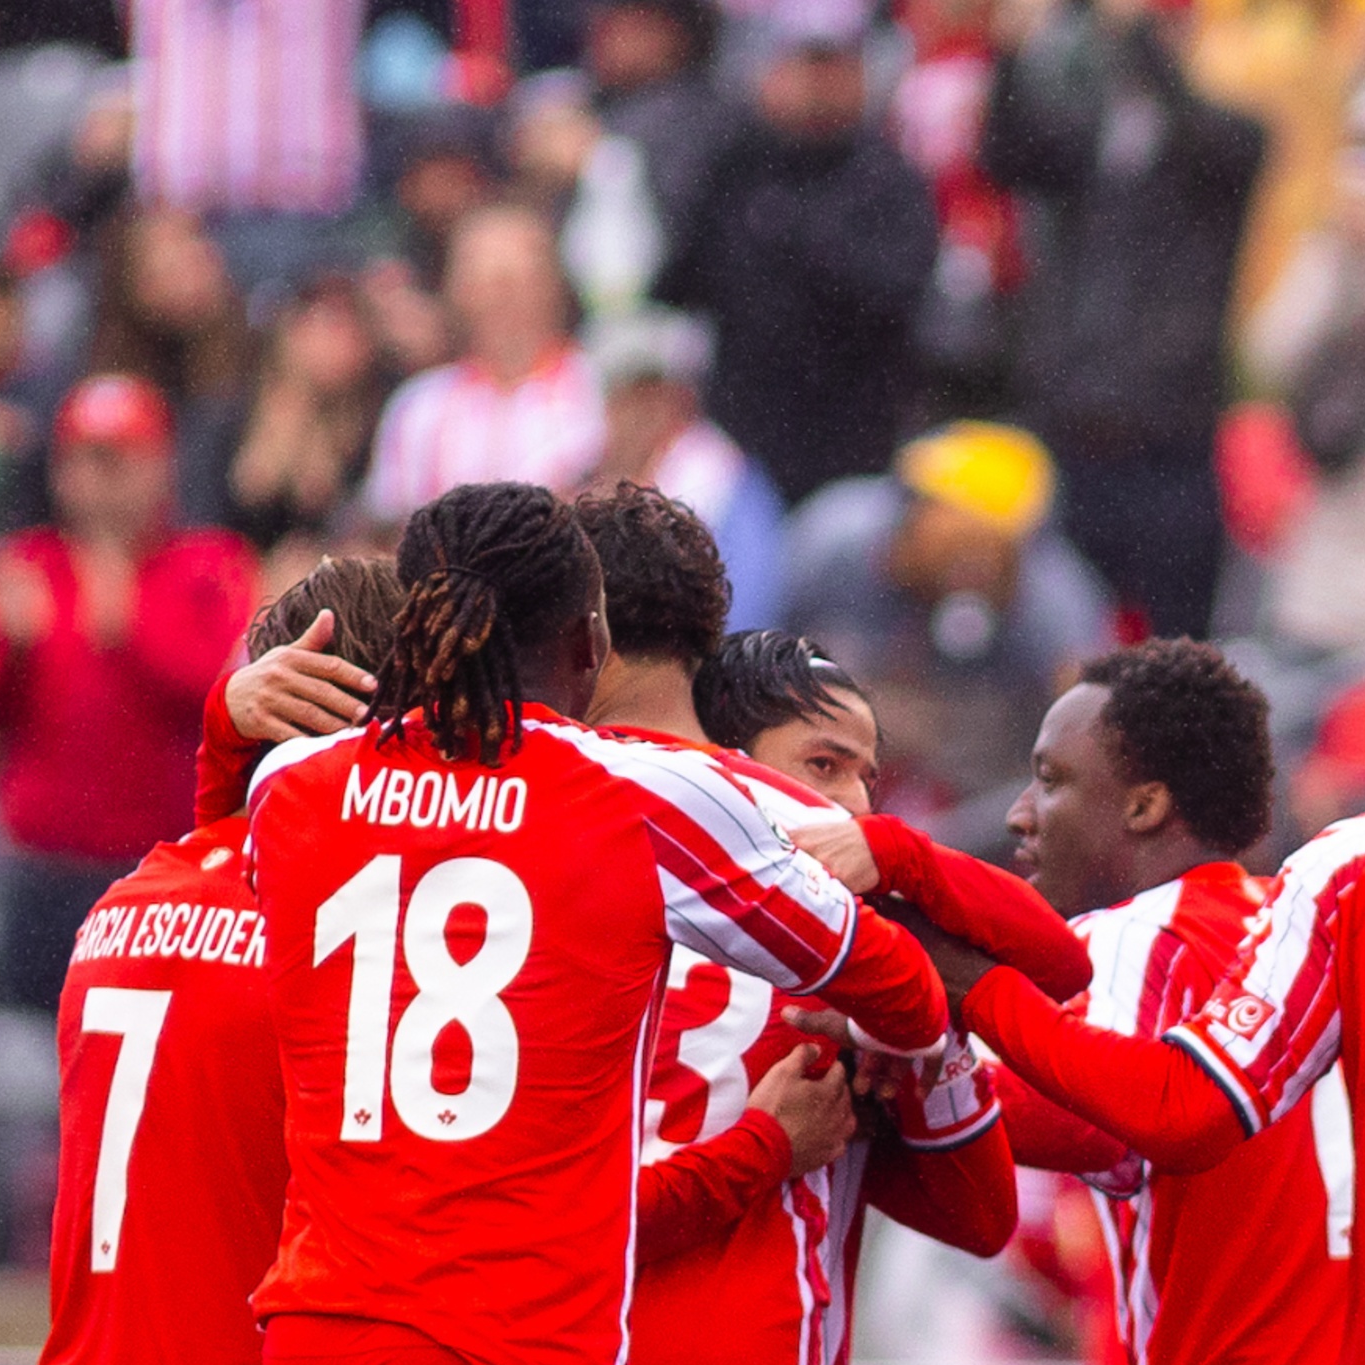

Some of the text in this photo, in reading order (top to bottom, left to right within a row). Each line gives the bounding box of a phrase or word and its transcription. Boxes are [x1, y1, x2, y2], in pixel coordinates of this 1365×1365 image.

[341, 763, 528, 833] MBOMIO
[70, 906, 137, 963] ARCIA
[312, 853, 533, 1141] 18
[81, 986, 173, 1272] 7
